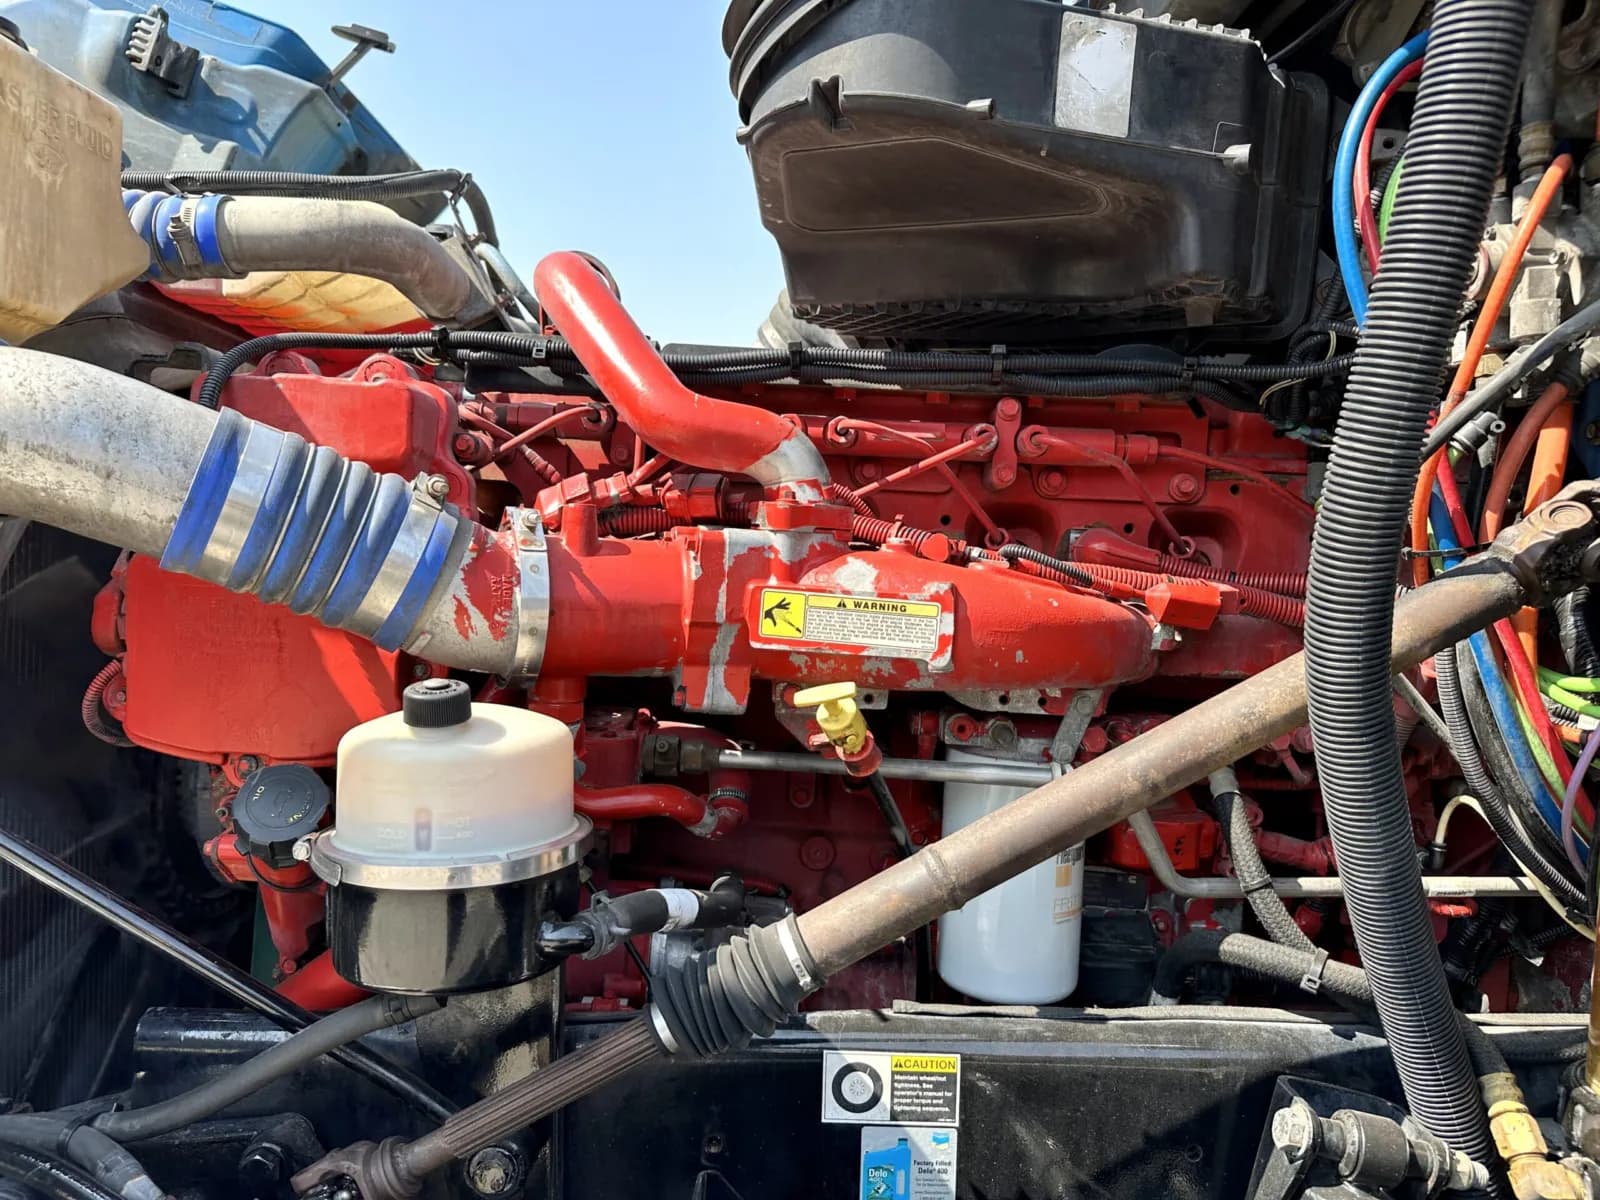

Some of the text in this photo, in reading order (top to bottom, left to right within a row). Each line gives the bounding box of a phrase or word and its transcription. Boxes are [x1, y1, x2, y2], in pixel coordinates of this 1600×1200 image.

[65, 112, 113, 160] FLUID
[853, 600, 908, 612] WARNING
[252, 785, 265, 801] OIL
[903, 1058, 956, 1070] CAUTION
[914, 1159, 934, 1168] Factory
[868, 1168, 888, 1178] Delo
